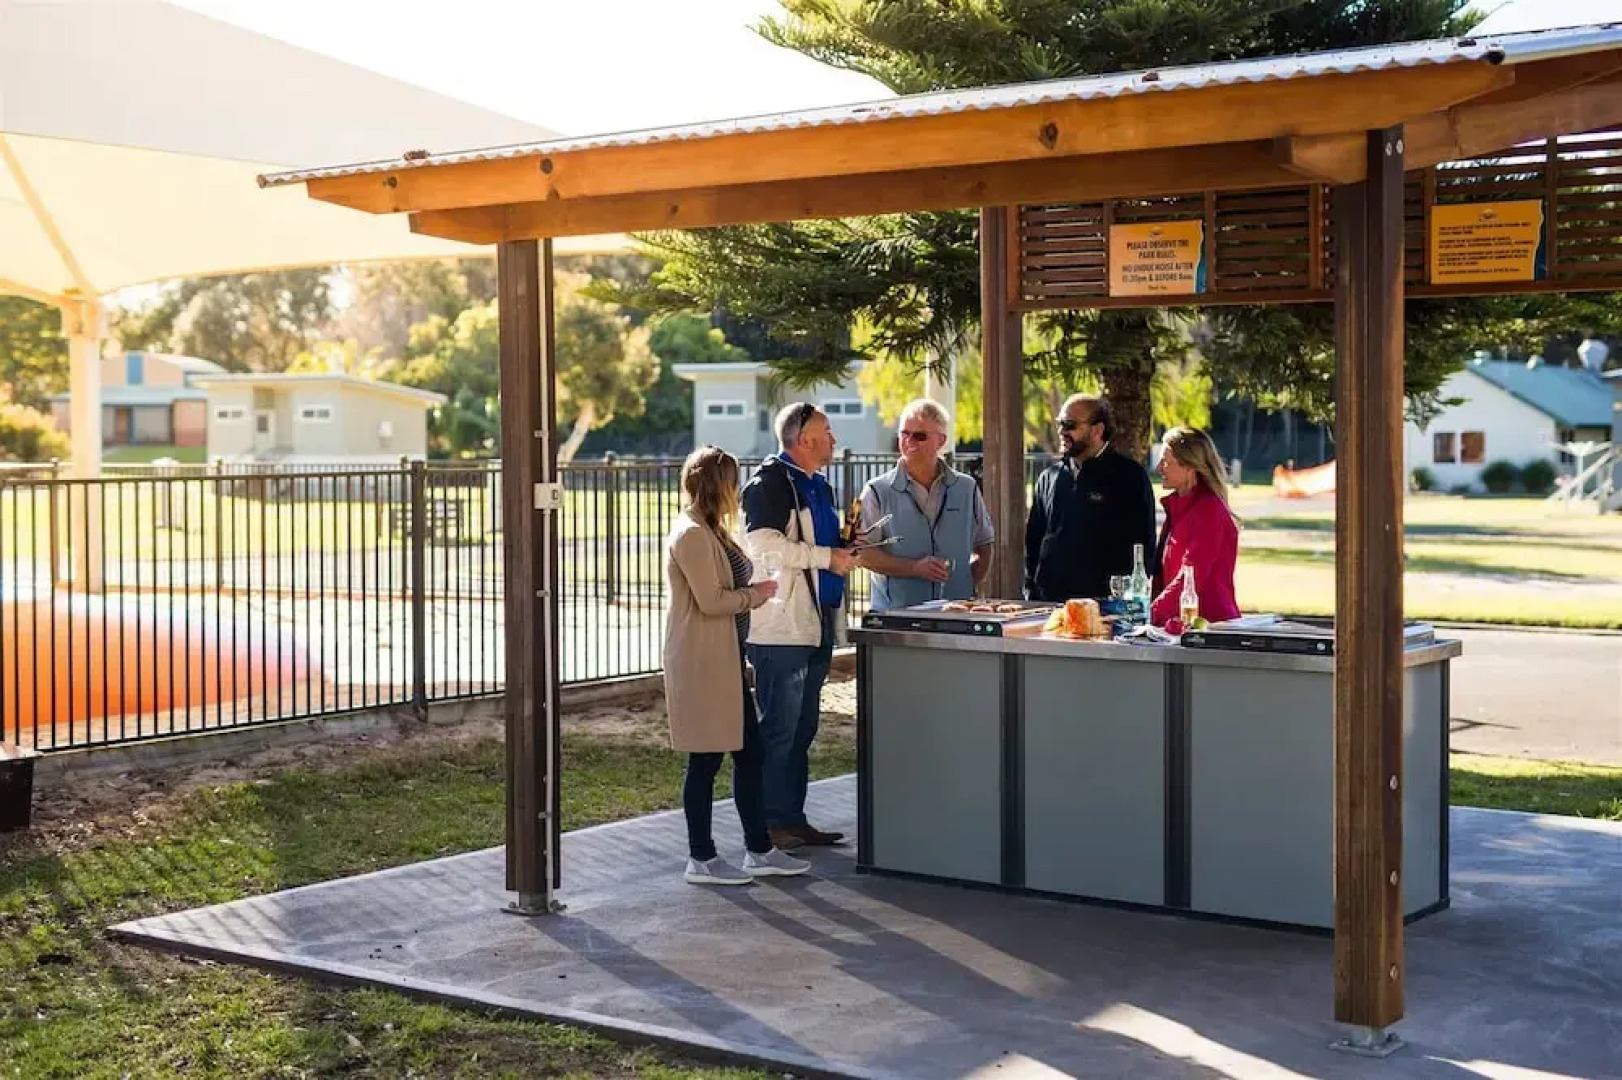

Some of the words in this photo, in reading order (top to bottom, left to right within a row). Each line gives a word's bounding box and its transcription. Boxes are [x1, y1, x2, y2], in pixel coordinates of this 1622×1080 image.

[1126, 241, 1148, 250] PLEASE
[1149, 240, 1176, 249] OBSERVE
[1177, 239, 1189, 247] THE
[1138, 251, 1155, 259] PARK
[1154, 263, 1174, 271] NOISE
[1175, 262, 1193, 270] AFTER
[1154, 273, 1177, 281] BEFORE
